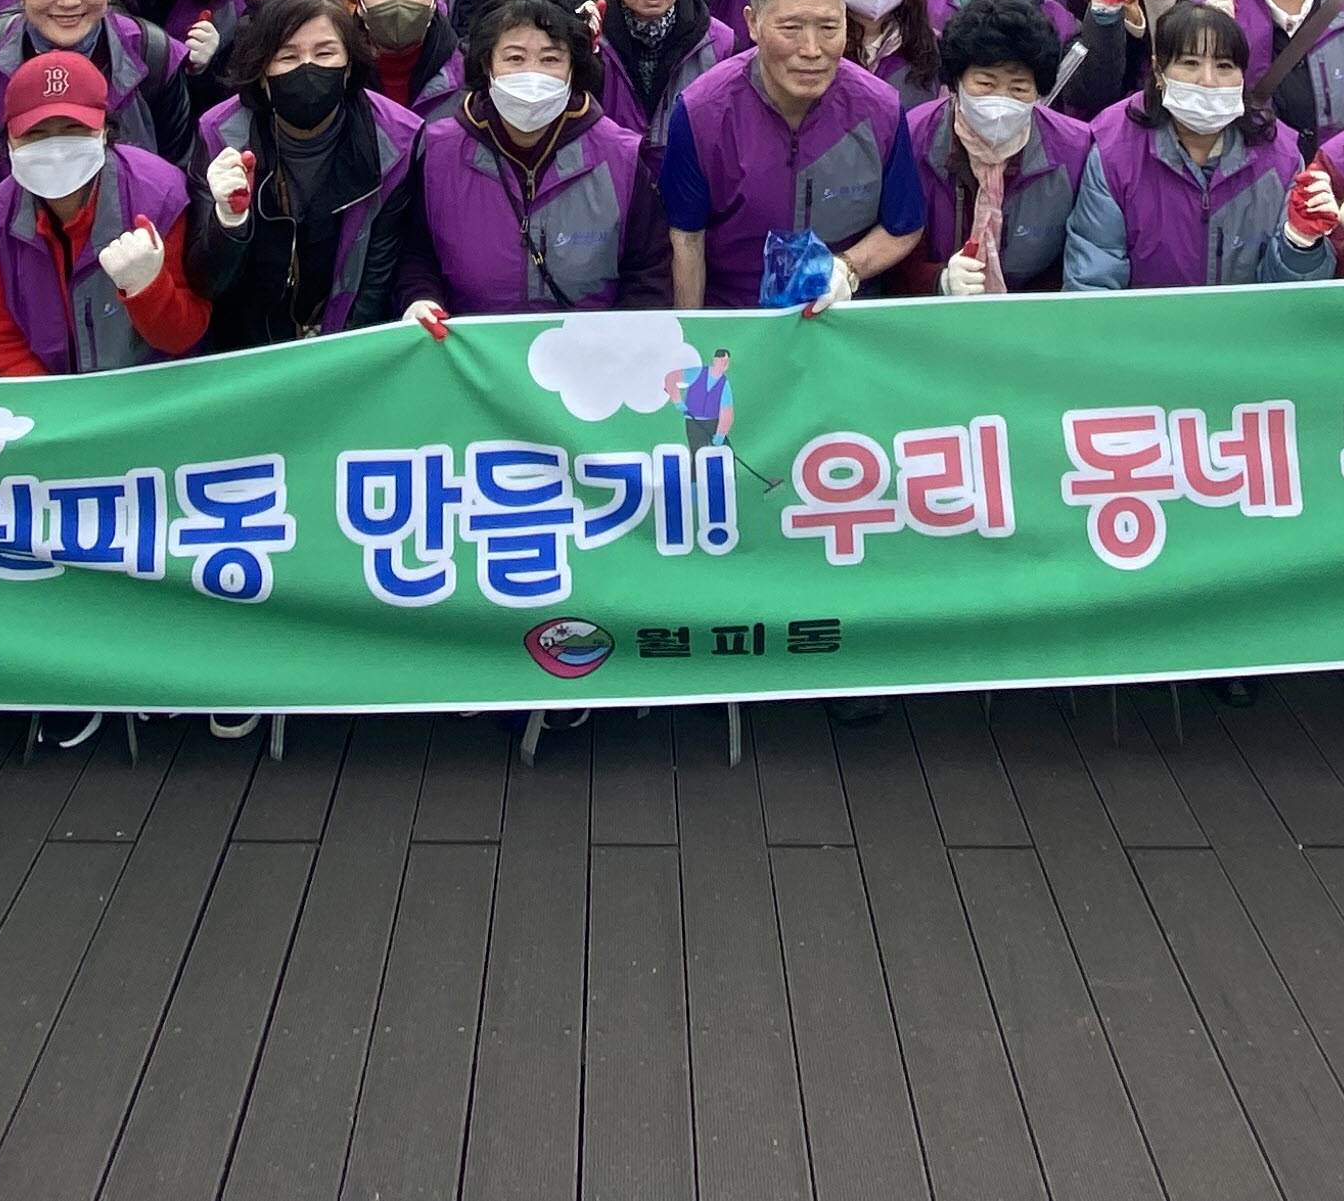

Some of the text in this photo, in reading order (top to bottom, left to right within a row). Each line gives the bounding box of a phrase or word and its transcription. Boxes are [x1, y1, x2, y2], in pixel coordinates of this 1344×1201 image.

[43, 65, 70, 97] B
[344, 448, 732, 600] 만들기!
[789, 423, 1008, 558] 우리
[1068, 406, 1296, 560] 동네
[635, 617, 843, 659] 월피동
